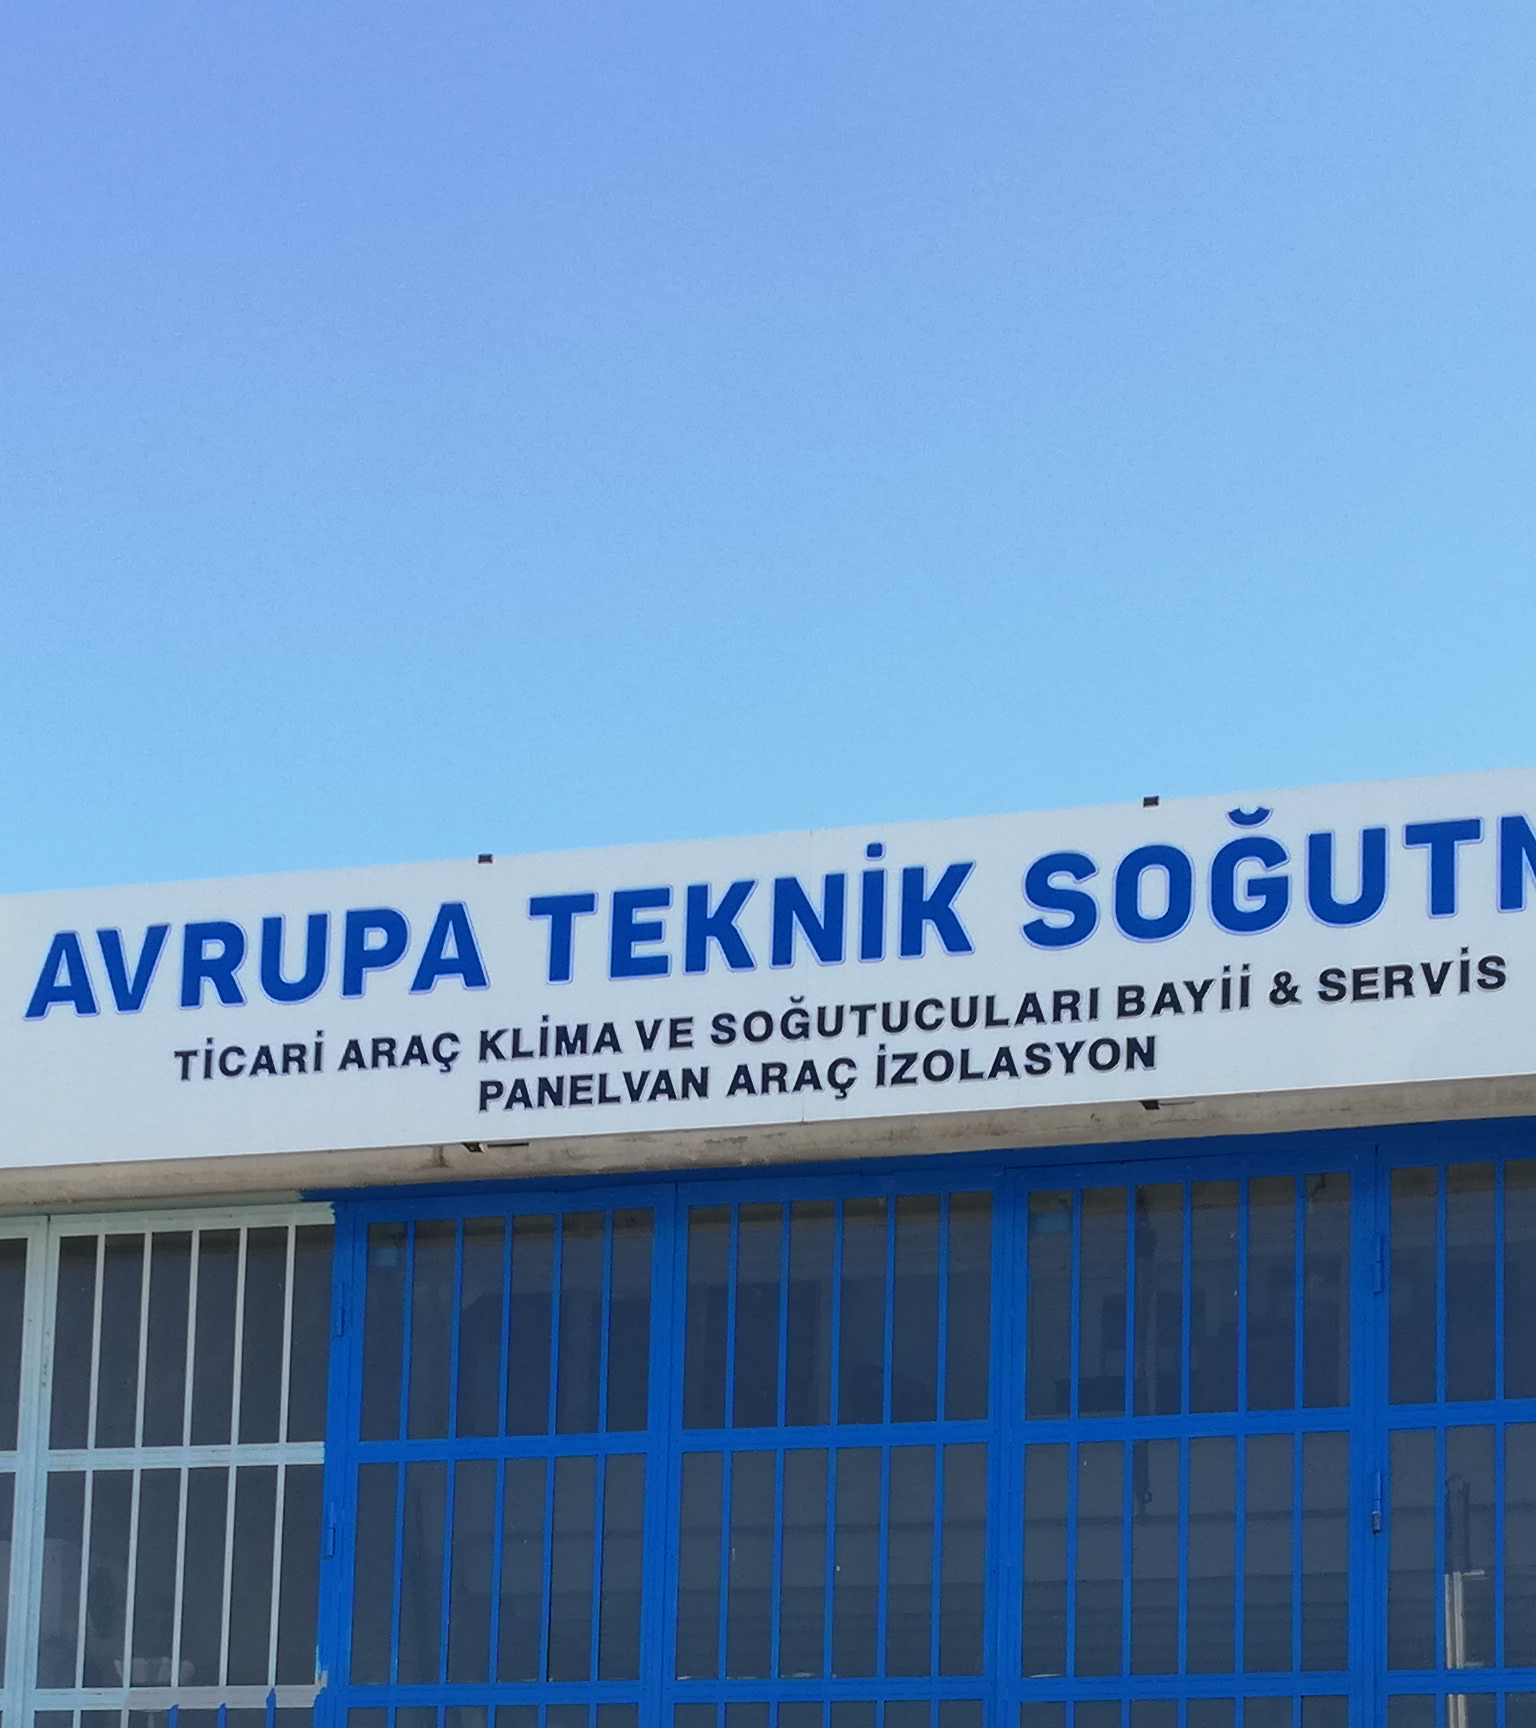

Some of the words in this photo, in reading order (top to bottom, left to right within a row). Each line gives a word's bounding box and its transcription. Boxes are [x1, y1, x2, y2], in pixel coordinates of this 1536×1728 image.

[23, 901, 490, 1020] AVRUPA
[527, 842, 975, 984] TEKNİK
[174, 1030, 325, 1081] TİCARİ
[337, 1032, 461, 1074] ARAÇ
[478, 1014, 623, 1062] KLİMA
[635, 1016, 695, 1051] VE
[710, 987, 1100, 1047] SOĞUTUCULARI
[1269, 970, 1301, 1007] &
[1317, 946, 1507, 1002] SERVİS
[478, 1066, 710, 1112] PANELVAN
[725, 1056, 858, 1099] ARAÇ
[874, 1035, 1157, 1089] İZOLASYON
